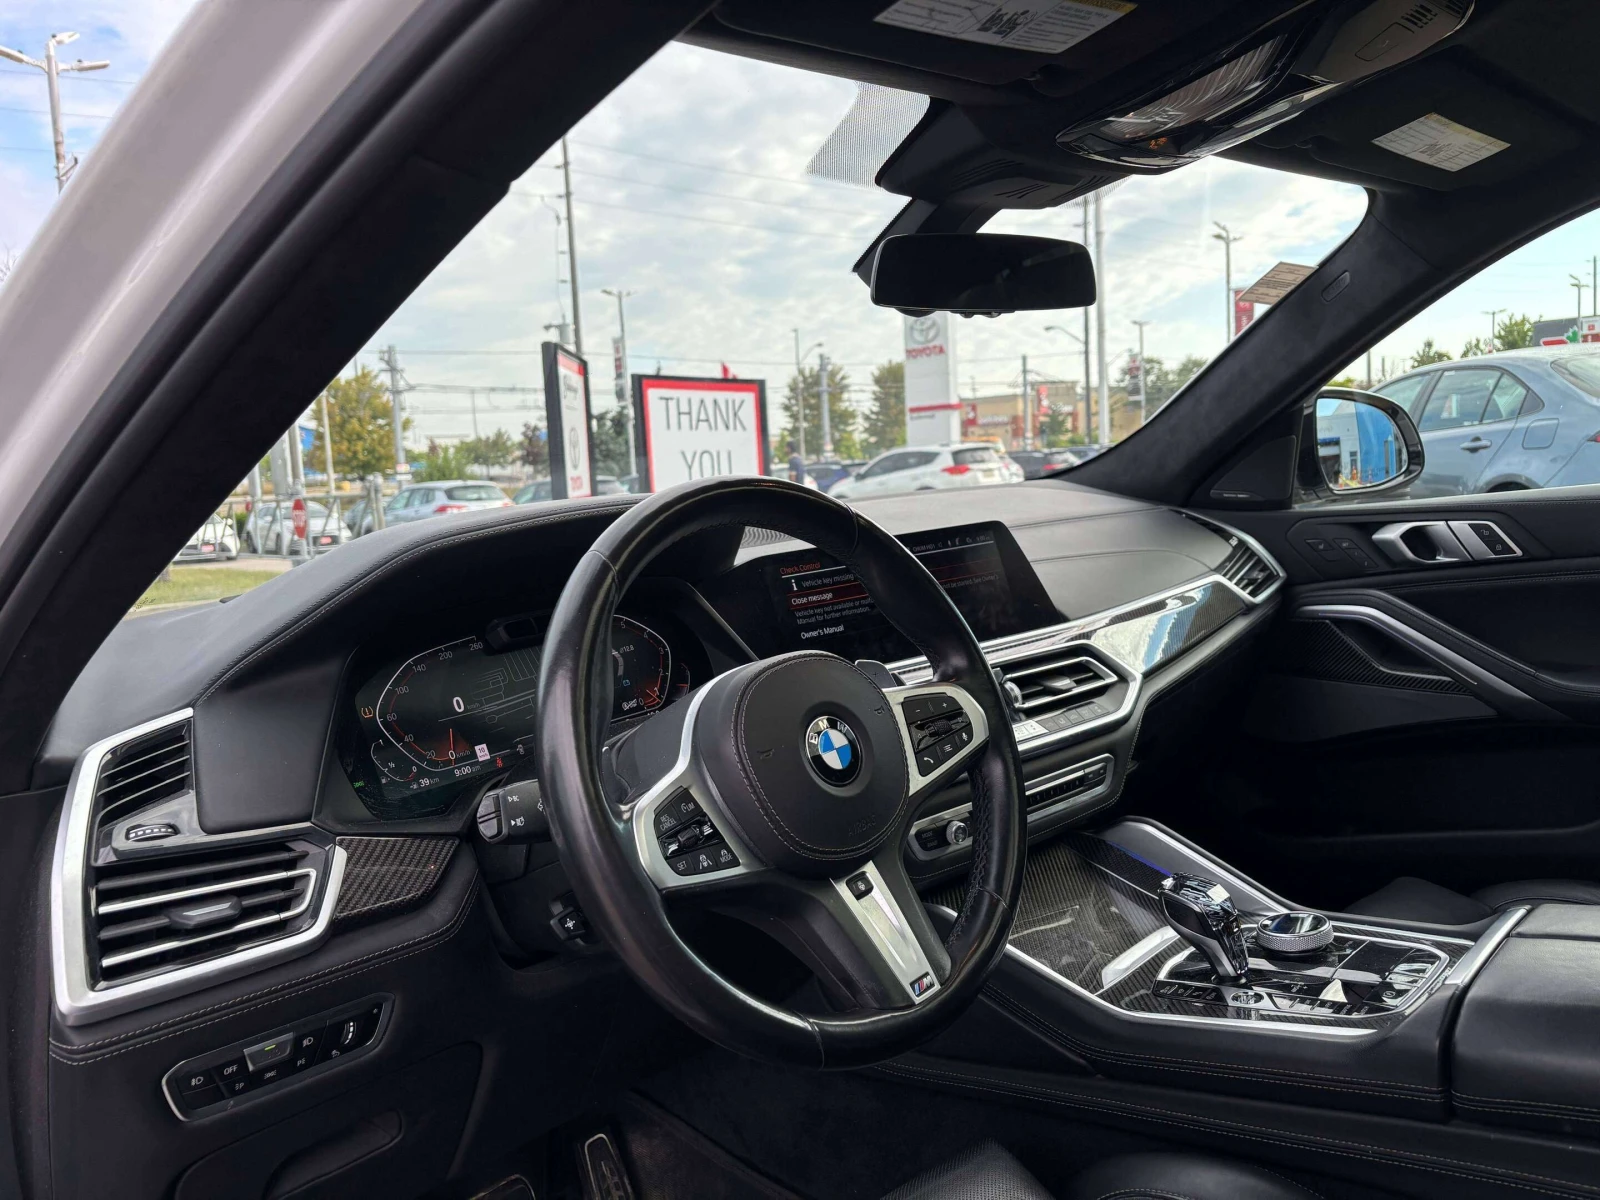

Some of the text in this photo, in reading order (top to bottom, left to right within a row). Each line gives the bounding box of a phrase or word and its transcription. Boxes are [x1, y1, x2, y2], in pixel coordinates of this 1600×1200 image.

[906, 344, 945, 359] TOYOTA
[657, 396, 747, 431] THANK
[680, 449, 733, 480] YOU
[780, 561, 820, 575] Check Control
[801, 573, 855, 587] Vehicle key missing
[791, 592, 833, 605] Close message
[794, 608, 814, 617] Vehicle
[814, 607, 824, 615] key
[824, 604, 833, 612] not
[833, 600, 854, 610] available
[796, 615, 817, 625] Manual
[824, 611, 841, 620] further
[841, 606, 871, 617] information.
[620, 621, 626, 629] 5
[643, 631, 649, 639] 4
[800, 624, 844, 640] Owner's Manual
[469, 641, 483, 651] 260
[659, 646, 665, 655] 3
[438, 650, 453, 660] 200
[412, 663, 426, 673] 140
[658, 668, 665, 676] 2
[394, 685, 409, 695] 100
[653, 686, 660, 696] 1
[452, 696, 465, 713] 0
[638, 697, 645, 706] 0
[386, 712, 397, 722] 60
[808, 718, 848, 745] BMW
[404, 733, 414, 743] 40
[425, 750, 436, 760] 20
[448, 750, 456, 760] 0
[411, 765, 418, 773] 0
[454, 764, 481, 777] 9:00 am
[419, 776, 440, 788] 39 km
[659, 817, 677, 831] CANCEL
[719, 852, 733, 864] MODE
[676, 860, 688, 871] SET
[223, 1063, 239, 1076] OFF
